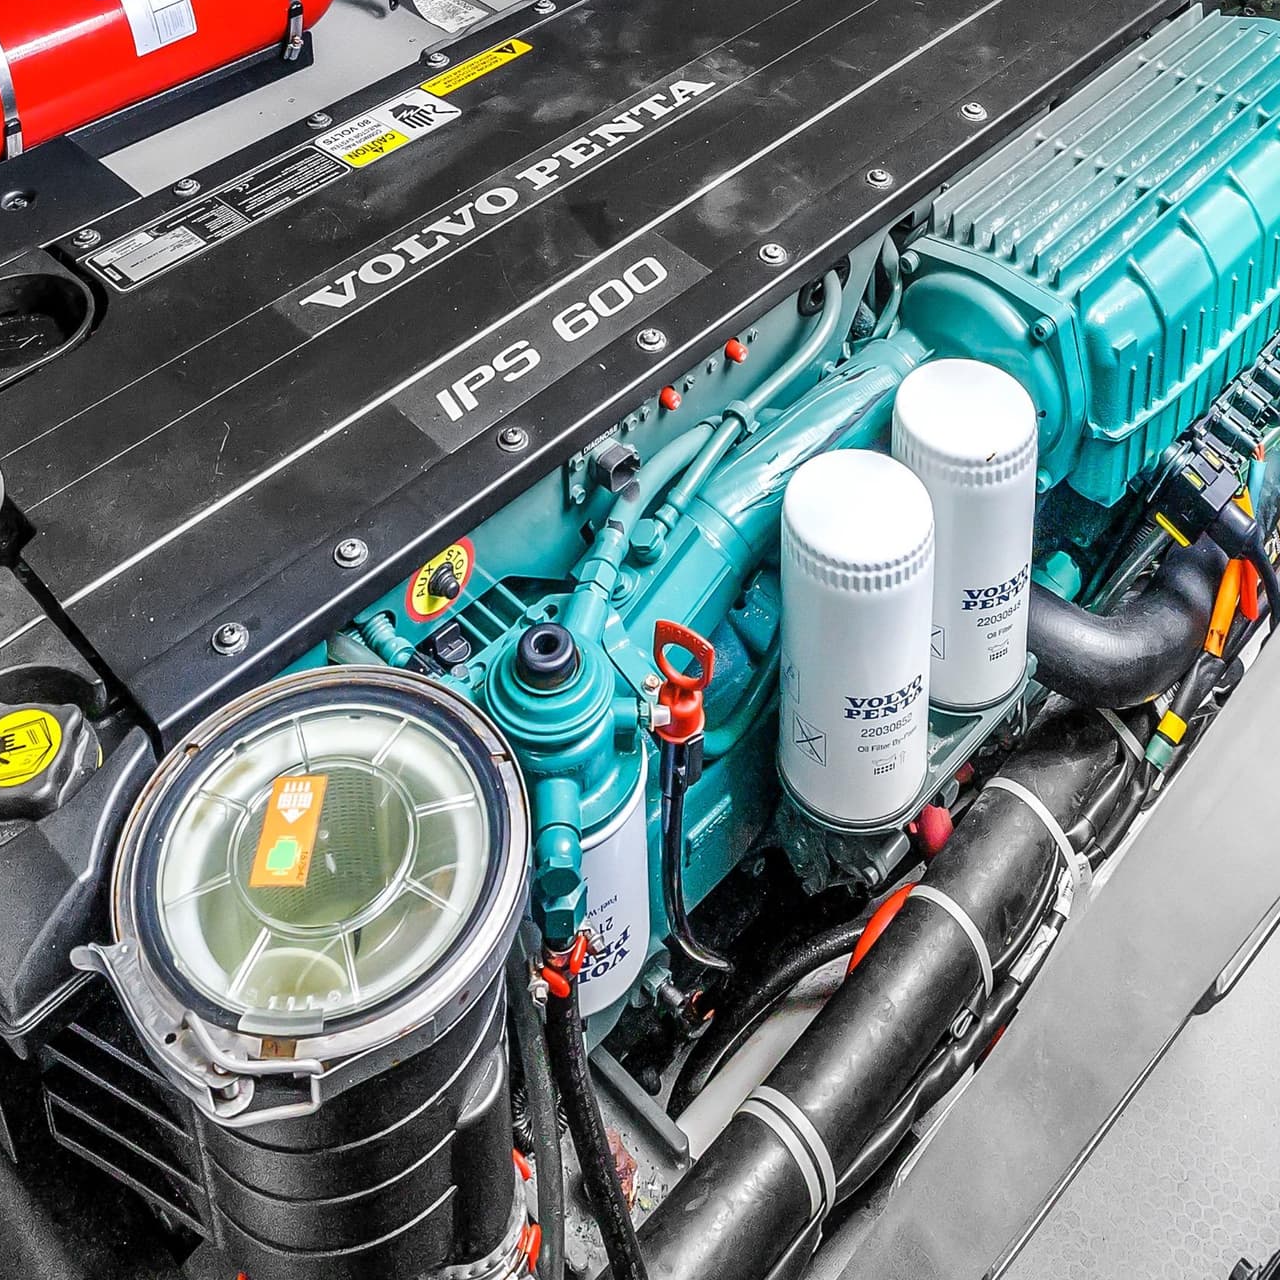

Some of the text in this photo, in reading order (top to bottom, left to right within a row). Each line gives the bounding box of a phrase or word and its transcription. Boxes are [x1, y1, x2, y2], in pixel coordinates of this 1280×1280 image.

[321, 118, 372, 145] 80 VOLTS
[346, 132, 396, 159] CAUTION
[299, 186, 520, 309] VOLVO
[515, 79, 716, 192] PENTA
[435, 256, 668, 422] IPS 600
[416, 549, 464, 597] AUX STOP
[843, 685, 923, 720] PENTA
[844, 674, 922, 709] VOLVO
[857, 745, 869, 753] Oil
